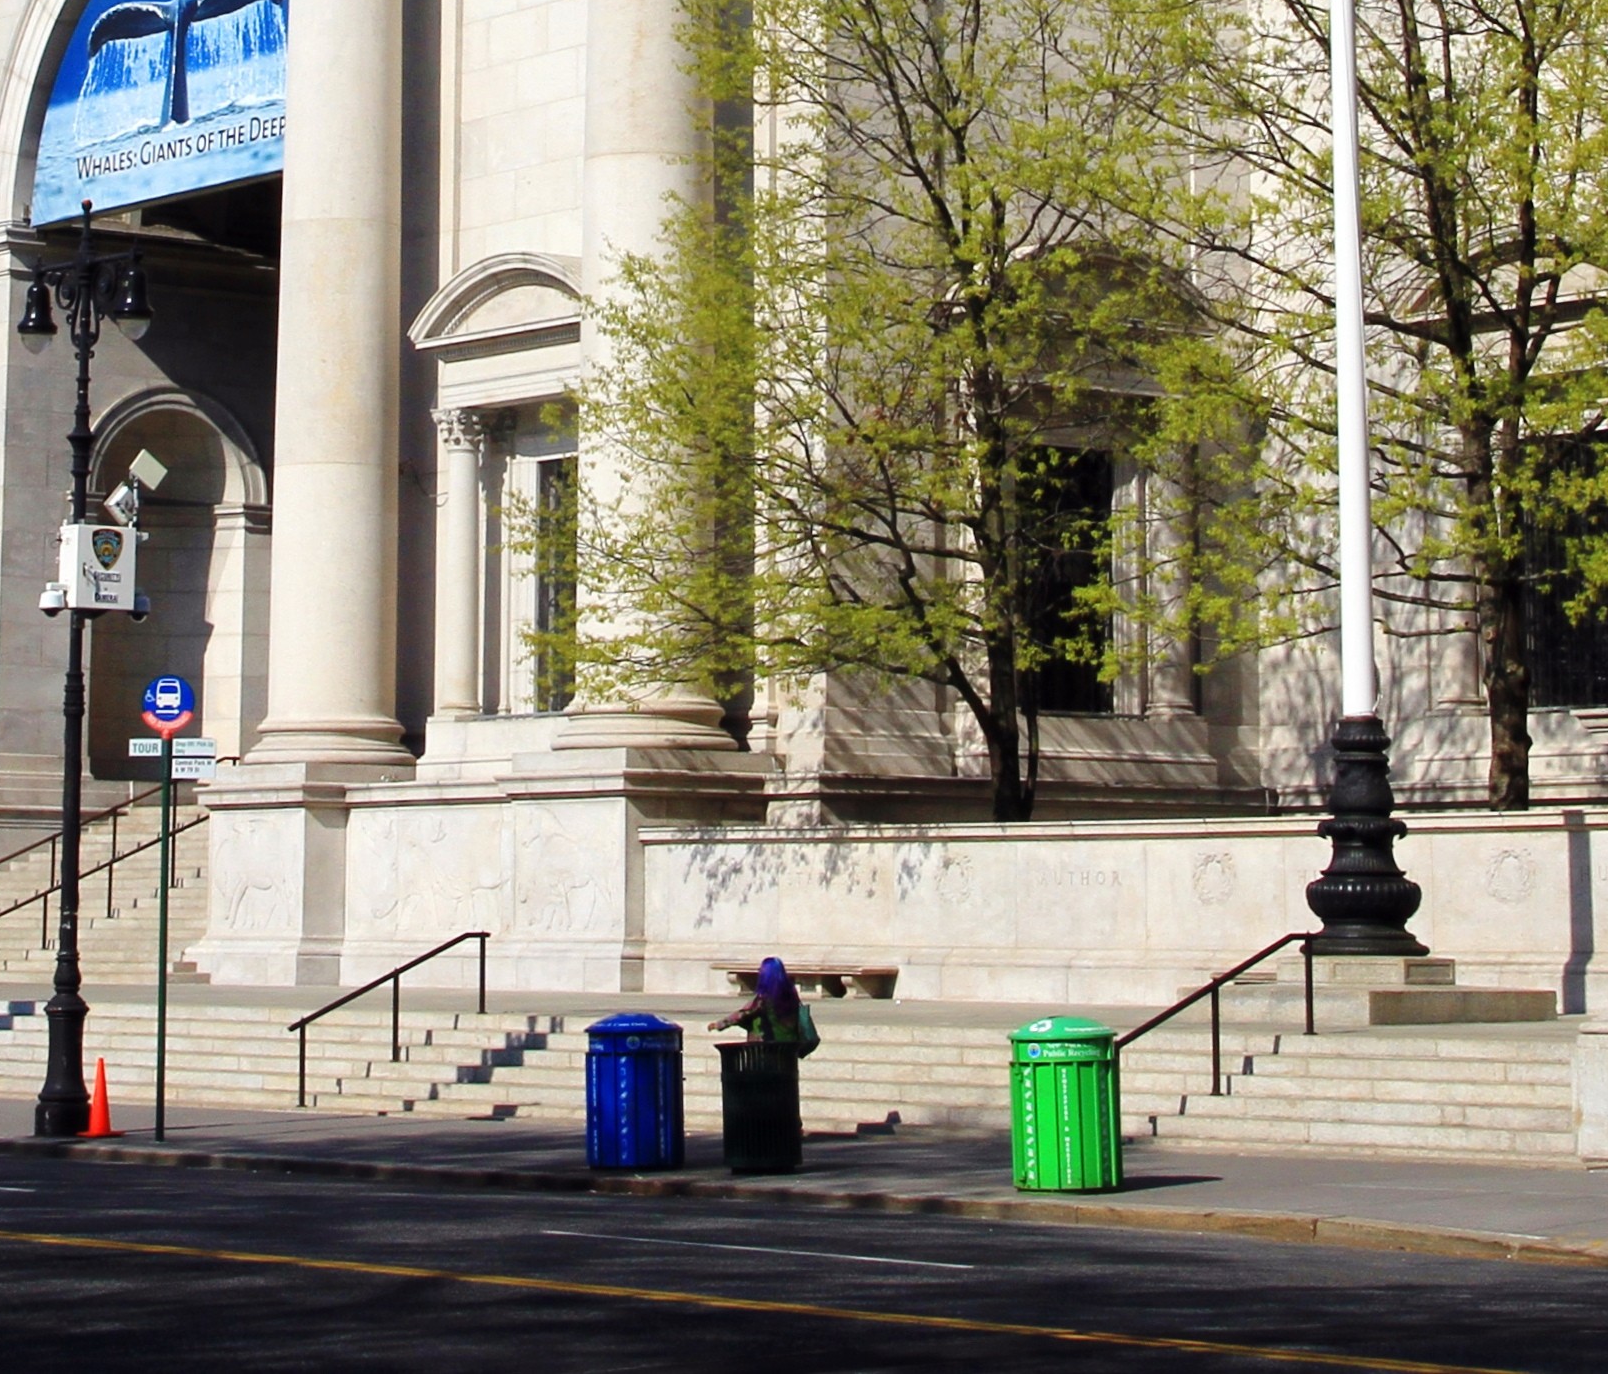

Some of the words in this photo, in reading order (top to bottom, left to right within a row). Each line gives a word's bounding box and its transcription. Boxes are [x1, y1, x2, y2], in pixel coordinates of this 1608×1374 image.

[77, 150, 138, 180] WHALES:
[140, 136, 193, 166] GIANTS
[196, 131, 215, 153] OF
[218, 124, 245, 149] THE
[132, 742, 160, 754] TOUR
[1036, 869, 1123, 887] AUTHOR
